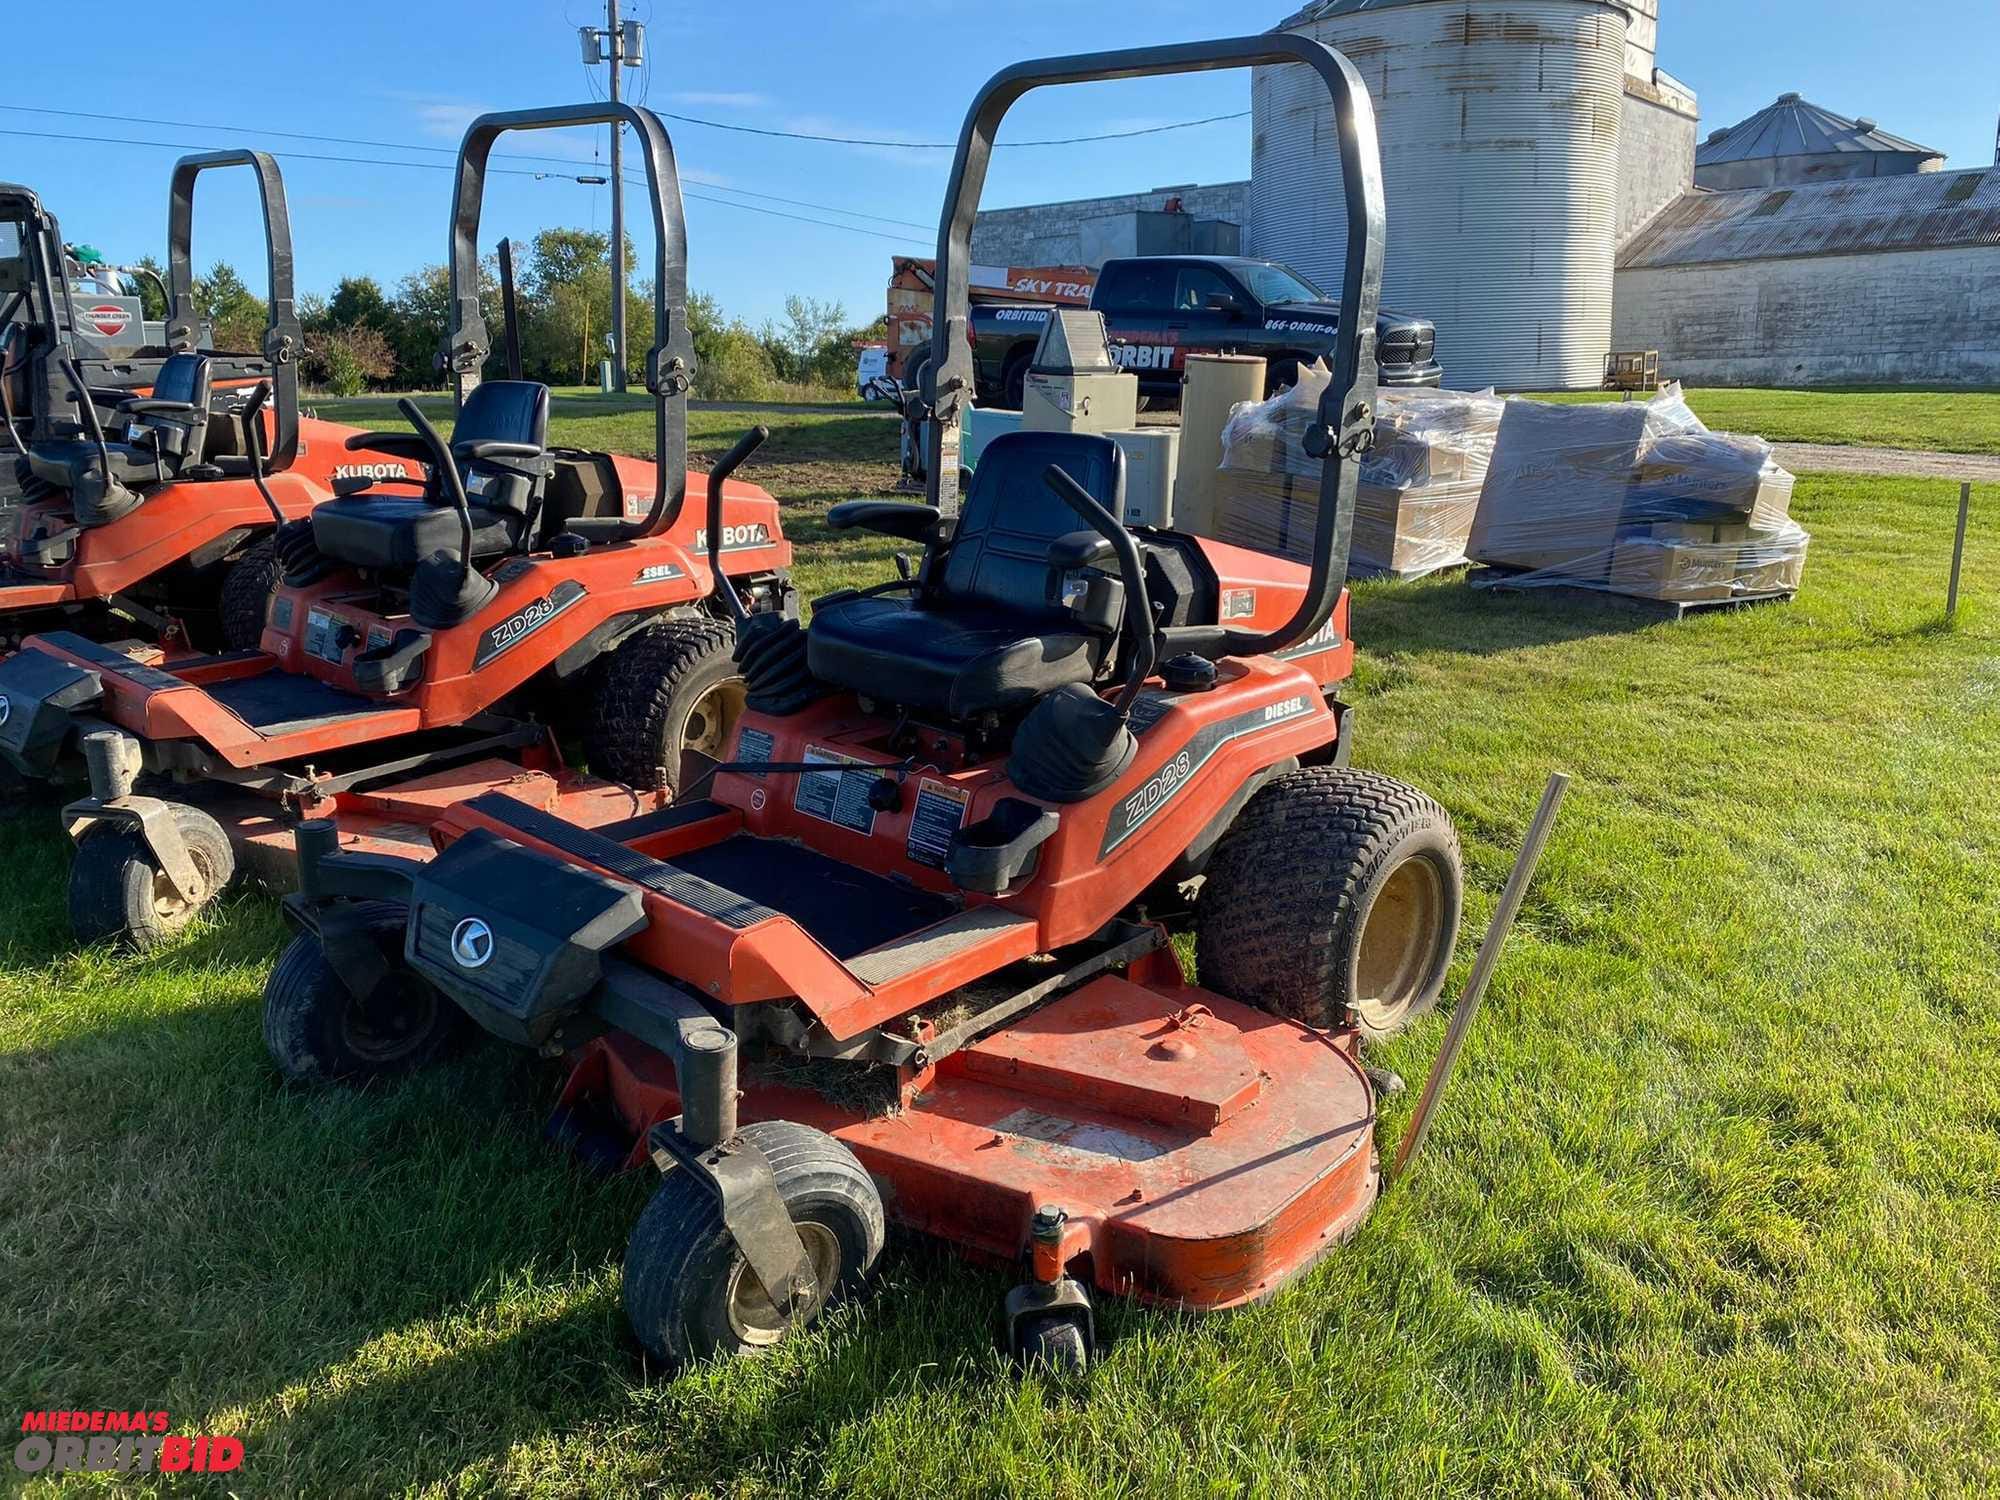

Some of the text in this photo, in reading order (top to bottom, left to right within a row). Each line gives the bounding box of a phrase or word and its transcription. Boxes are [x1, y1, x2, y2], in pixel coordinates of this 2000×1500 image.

[1014, 278, 1053, 293] SKY
[335, 463, 407, 479] KUBOTA
[695, 524, 769, 548] KBOTA
[491, 596, 554, 648] ZD28
[1264, 696, 1303, 721] DIESEL
[1125, 751, 1190, 828] ZD28
